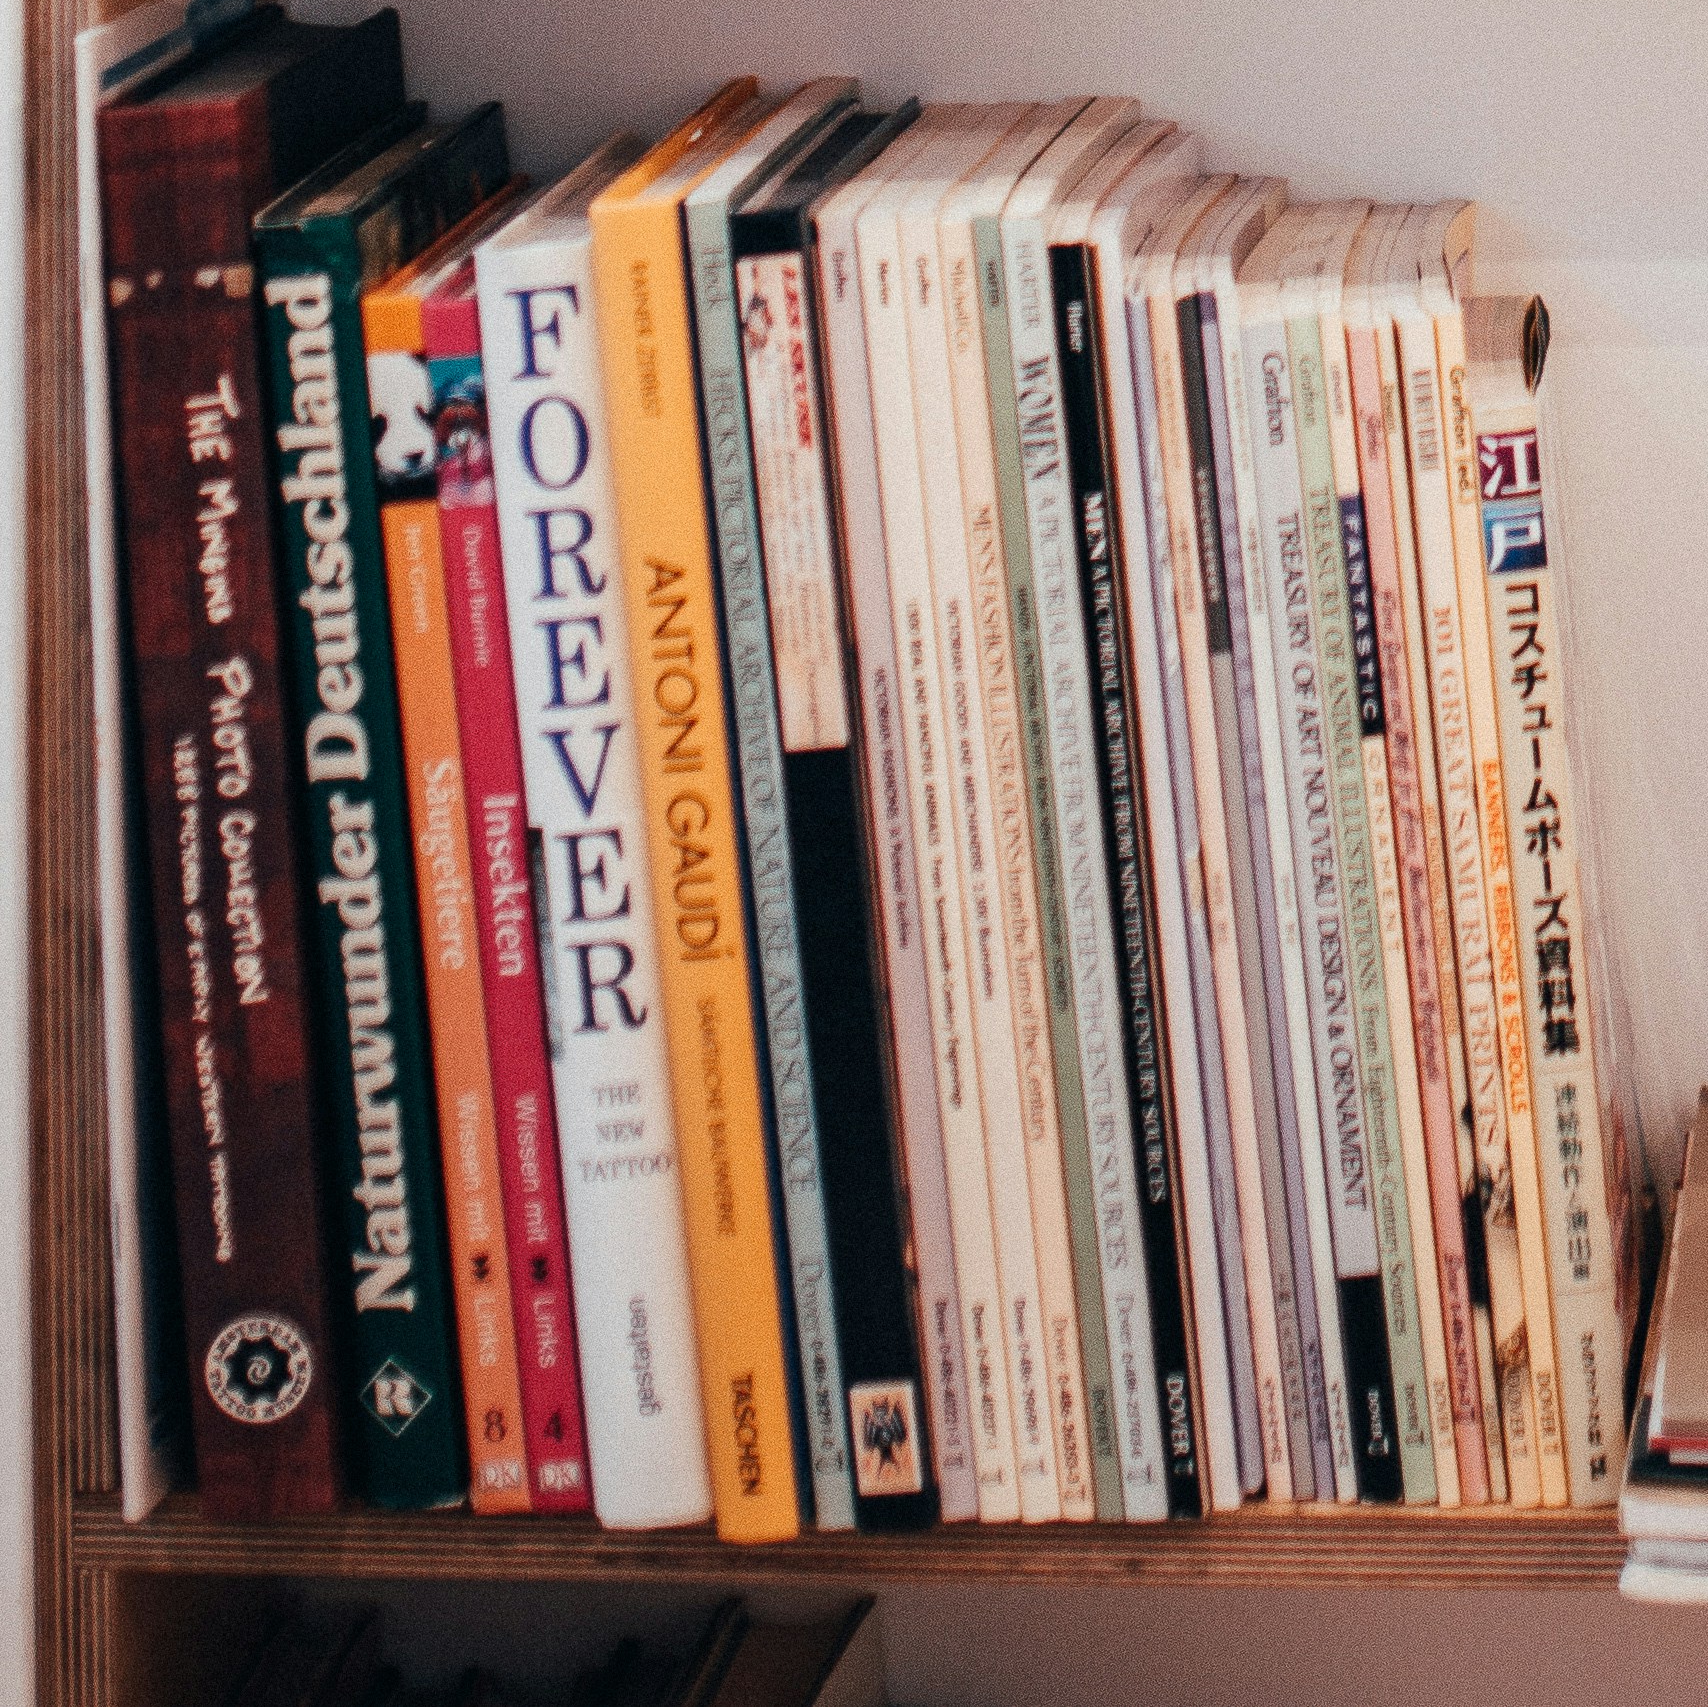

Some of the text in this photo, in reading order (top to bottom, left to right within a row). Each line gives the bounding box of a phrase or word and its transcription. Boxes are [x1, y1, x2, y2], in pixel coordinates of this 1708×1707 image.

[702, 244, 732, 310] Heck
[1015, 239, 1042, 331] HARTER
[184, 374, 240, 463] THE
[1013, 352, 1062, 482] WOMEN
[1260, 350, 1293, 446] Grafton
[1295, 353, 1324, 427] Grafton
[1448, 366, 1470, 450] Grafton
[718, 474, 758, 626] PICTORIAL
[1033, 491, 1057, 510] A
[1080, 491, 1107, 562] MEN
[1308, 483, 1341, 618] TREASURY
[462, 524, 494, 670] David Burnie
[974, 577, 1008, 679] FASHION
[1035, 512, 1071, 650] PICTORIAL
[1432, 606, 1454, 654] 101
[504, 282, 649, 1037] FOREVER
[1090, 579, 1119, 693] PICTORIAL
[1321, 625, 1346, 662] OF
[204, 656, 257, 799] PHOTO
[735, 638, 774, 770] ARCHIVE
[1048, 659, 1083, 772] ARCHIVE
[1101, 698, 1128, 793] ARCHIVE
[1326, 668, 1356, 770] ANIMAL
[1341, 514, 1402, 953] FANTASTIC ORNAMENT
[1437, 666, 1467, 791] GREAT
[263, 272, 416, 1315] Naturwunder Deutschland
[641, 552, 735, 965] ANTONI GAUDÍ
[748, 773, 778, 813] OF
[984, 681, 1026, 866] ILLUSTRATIONS
[1058, 776, 1089, 844] FROM
[1110, 794, 1134, 859] FROM
[1503, 583, 1579, 1054] コスチュームポーズ資料集
[412, 755, 475, 970] Säugetiere
[480, 791, 533, 976] Insekten
[752, 826, 791, 960] NATURE
[1275, 511, 1367, 1212] TREASURY OF ART NOUVEAU DESIGN & ORNAMENT
[1336, 780, 1379, 993] ILLUSTRATIONS
[1448, 811, 1485, 983] SAMURAI
[1010, 913, 1032, 946] the
[1480, 758, 1528, 1113] BANNERS, RIBBONS & SCROLLS
[766, 975, 801, 1055] AND
[1020, 1021, 1043, 1051] the
[1360, 1003, 1384, 1057] From
[592, 1081, 643, 1113] THE
[1020, 1051, 1053, 1142] Century
[1466, 1003, 1500, 1147] PRINTS
[578, 1149, 673, 1183] TATTOO
[595, 1118, 648, 1148] NEW
[774, 1059, 814, 1195] SCIENCE
[1140, 1103, 1166, 1202] SOURCES
[452, 1090, 500, 1366] Wissen mit Links
[514, 1093, 562, 1369] Wissen mit Links
[1095, 1155, 1128, 1270] SOURCES
[1386, 1261, 1412, 1335] Sources
[630, 1299, 662, 1416] gestalten
[1537, 1372, 1555, 1423] DOVER
[481, 1408, 507, 1443] 8
[540, 1408, 566, 1443] 4
[728, 1371, 763, 1497] TASCHEN
[1164, 1375, 1189, 1455] DOVER
[1367, 1389, 1383, 1438] DOVER
